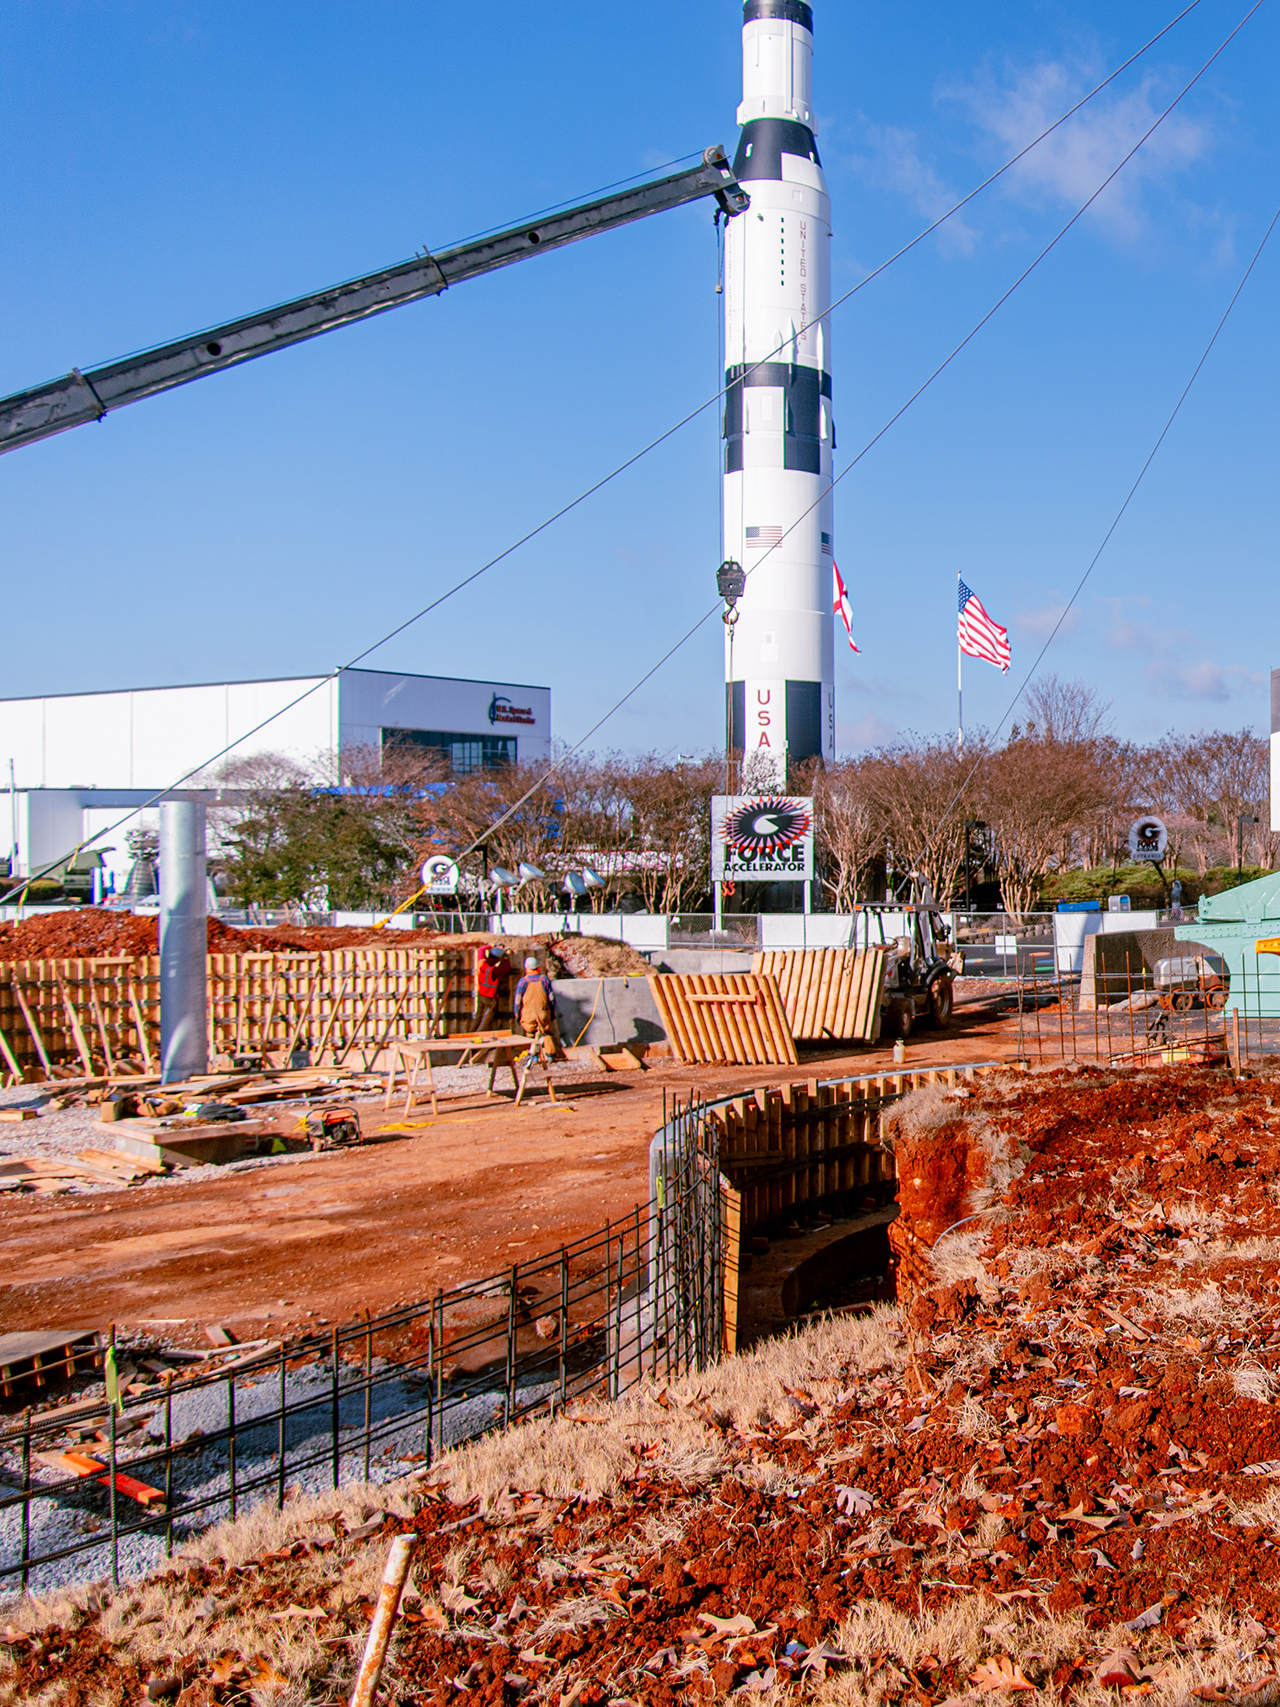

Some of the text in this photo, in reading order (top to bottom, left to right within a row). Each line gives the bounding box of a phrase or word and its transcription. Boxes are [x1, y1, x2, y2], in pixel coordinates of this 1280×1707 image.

[757, 689, 771, 748] USA
[724, 845, 805, 863] FORCE
[724, 862, 805, 872] ACCELERATOR
